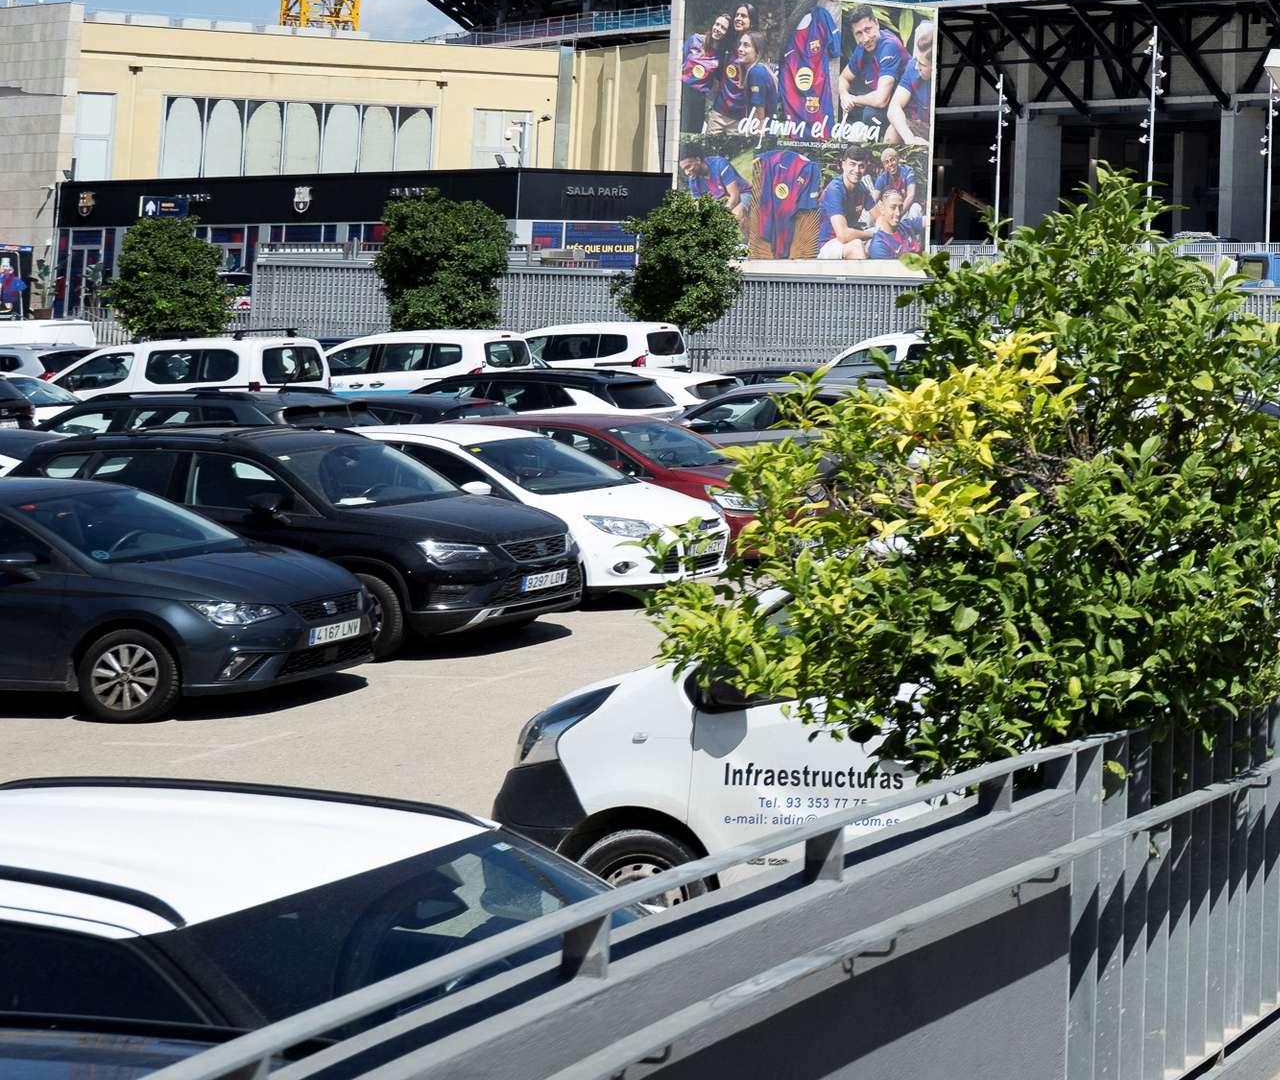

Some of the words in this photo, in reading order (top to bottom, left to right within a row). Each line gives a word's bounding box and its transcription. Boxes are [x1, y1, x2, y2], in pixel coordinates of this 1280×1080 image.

[738, 107, 806, 148] definim
[811, 113, 827, 139] el
[566, 186, 595, 196] SALA
[598, 185, 629, 196] PARÍS
[585, 245, 604, 254] QUE
[604, 245, 614, 253] UN
[614, 245, 635, 253] CLUB
[316, 625, 340, 640] 4167
[724, 762, 904, 790] Infraestructuras
[759, 797, 781, 808] Tel.
[786, 798, 801, 808] 93
[808, 798, 829, 809] 353
[834, 798, 848, 809] 77
[724, 814, 767, 825] e-mail:
